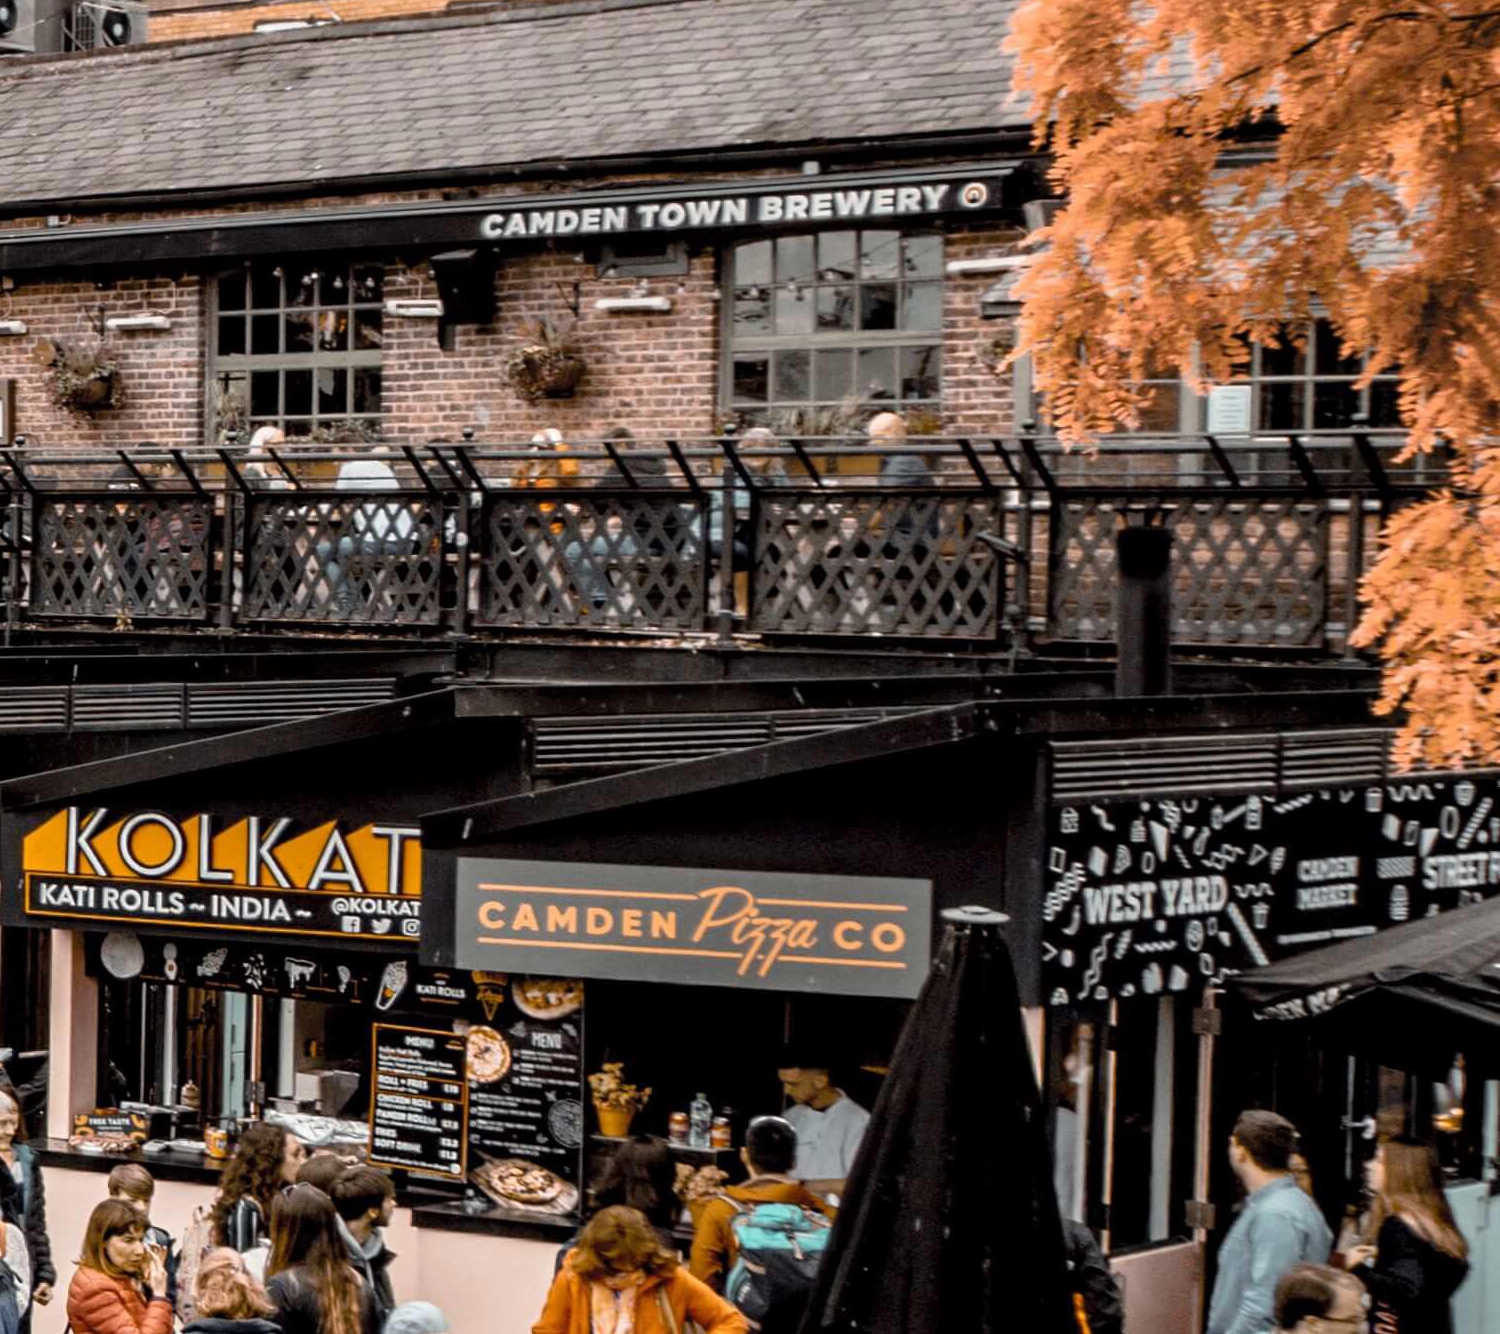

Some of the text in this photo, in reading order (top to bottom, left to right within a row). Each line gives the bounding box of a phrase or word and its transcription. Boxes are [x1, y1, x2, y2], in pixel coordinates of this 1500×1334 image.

[481, 184, 949, 238] CAMDEN TOWN BREWERY
[1422, 852, 1488, 890] STREET
[39, 881, 292, 922] KATI ROLLS INDIA
[1083, 874, 1228, 926] WEST YARD
[478, 885, 907, 977] CAMDEN Pizza CO
[531, 1032, 563, 1049] MENU
